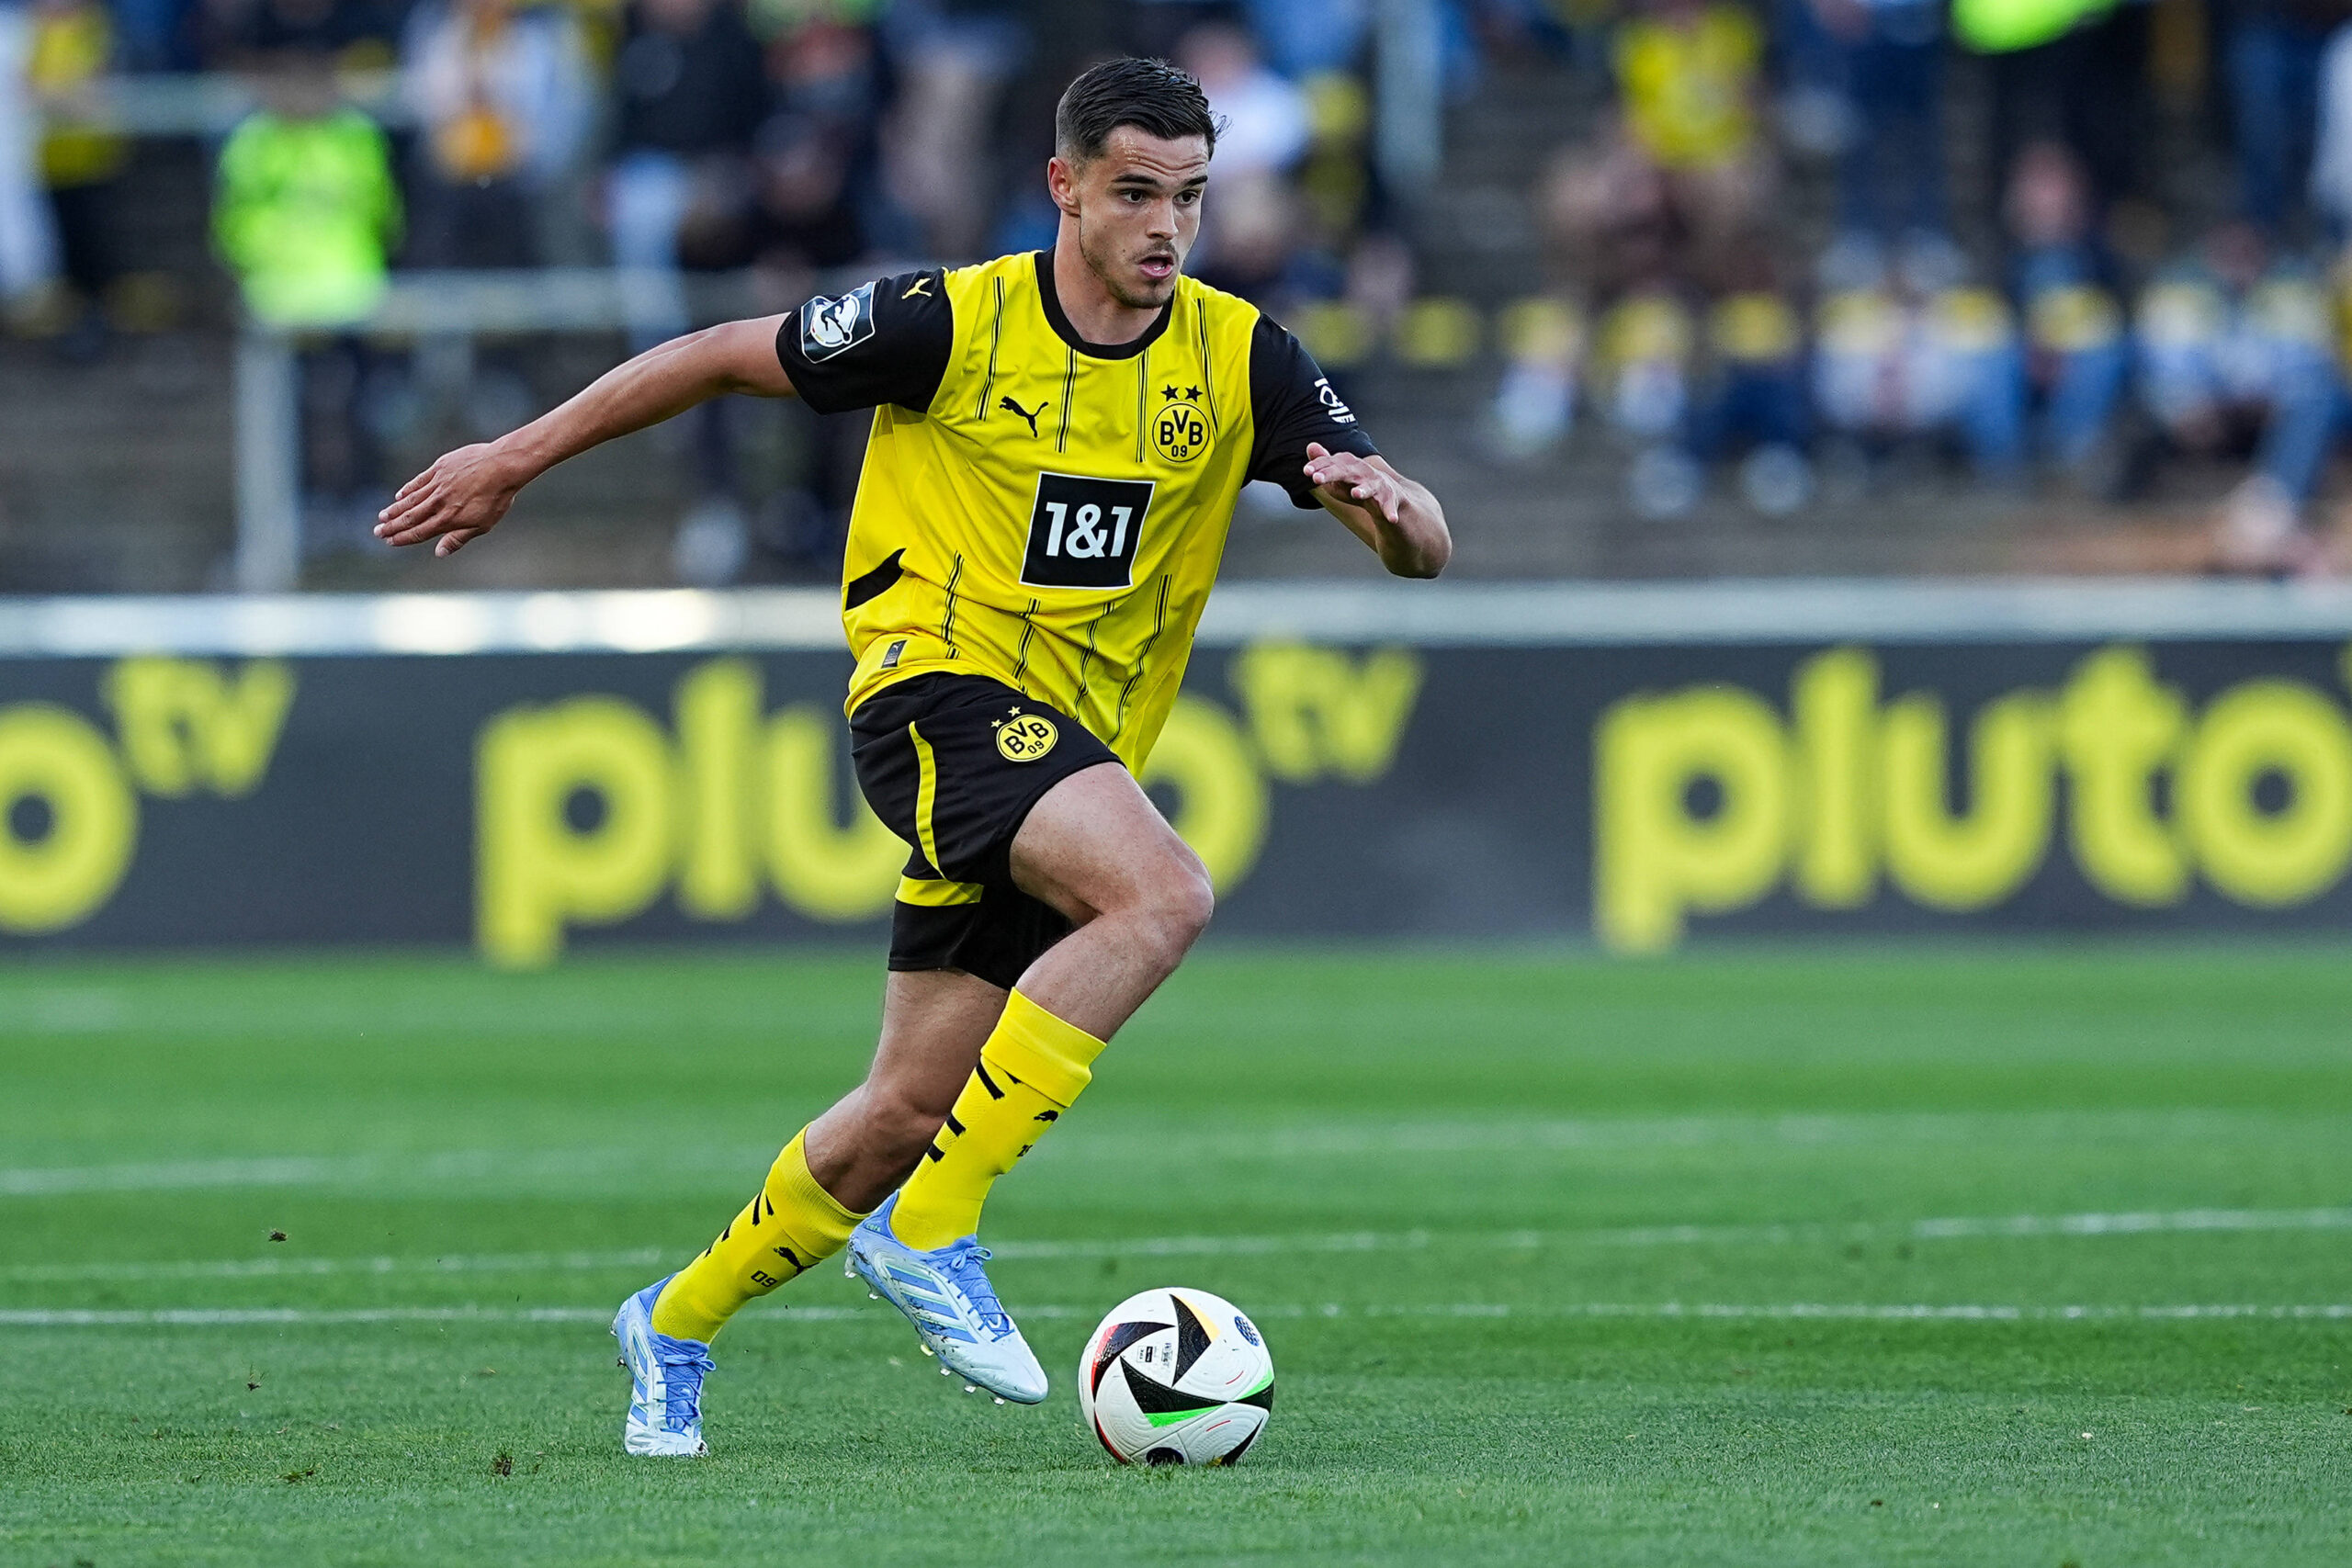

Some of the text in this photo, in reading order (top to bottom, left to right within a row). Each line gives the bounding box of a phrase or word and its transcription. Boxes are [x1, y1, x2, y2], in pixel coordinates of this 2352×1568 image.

[1159, 410, 1204, 446] BVB
[1171, 445, 1188, 457] 09
[1046, 502, 1133, 558] 1&1
[1004, 721, 1049, 754] BVB
[1027, 740, 1045, 754] 09
[1594, 645, 2352, 953] pluto
[751, 1270, 777, 1287] 09
